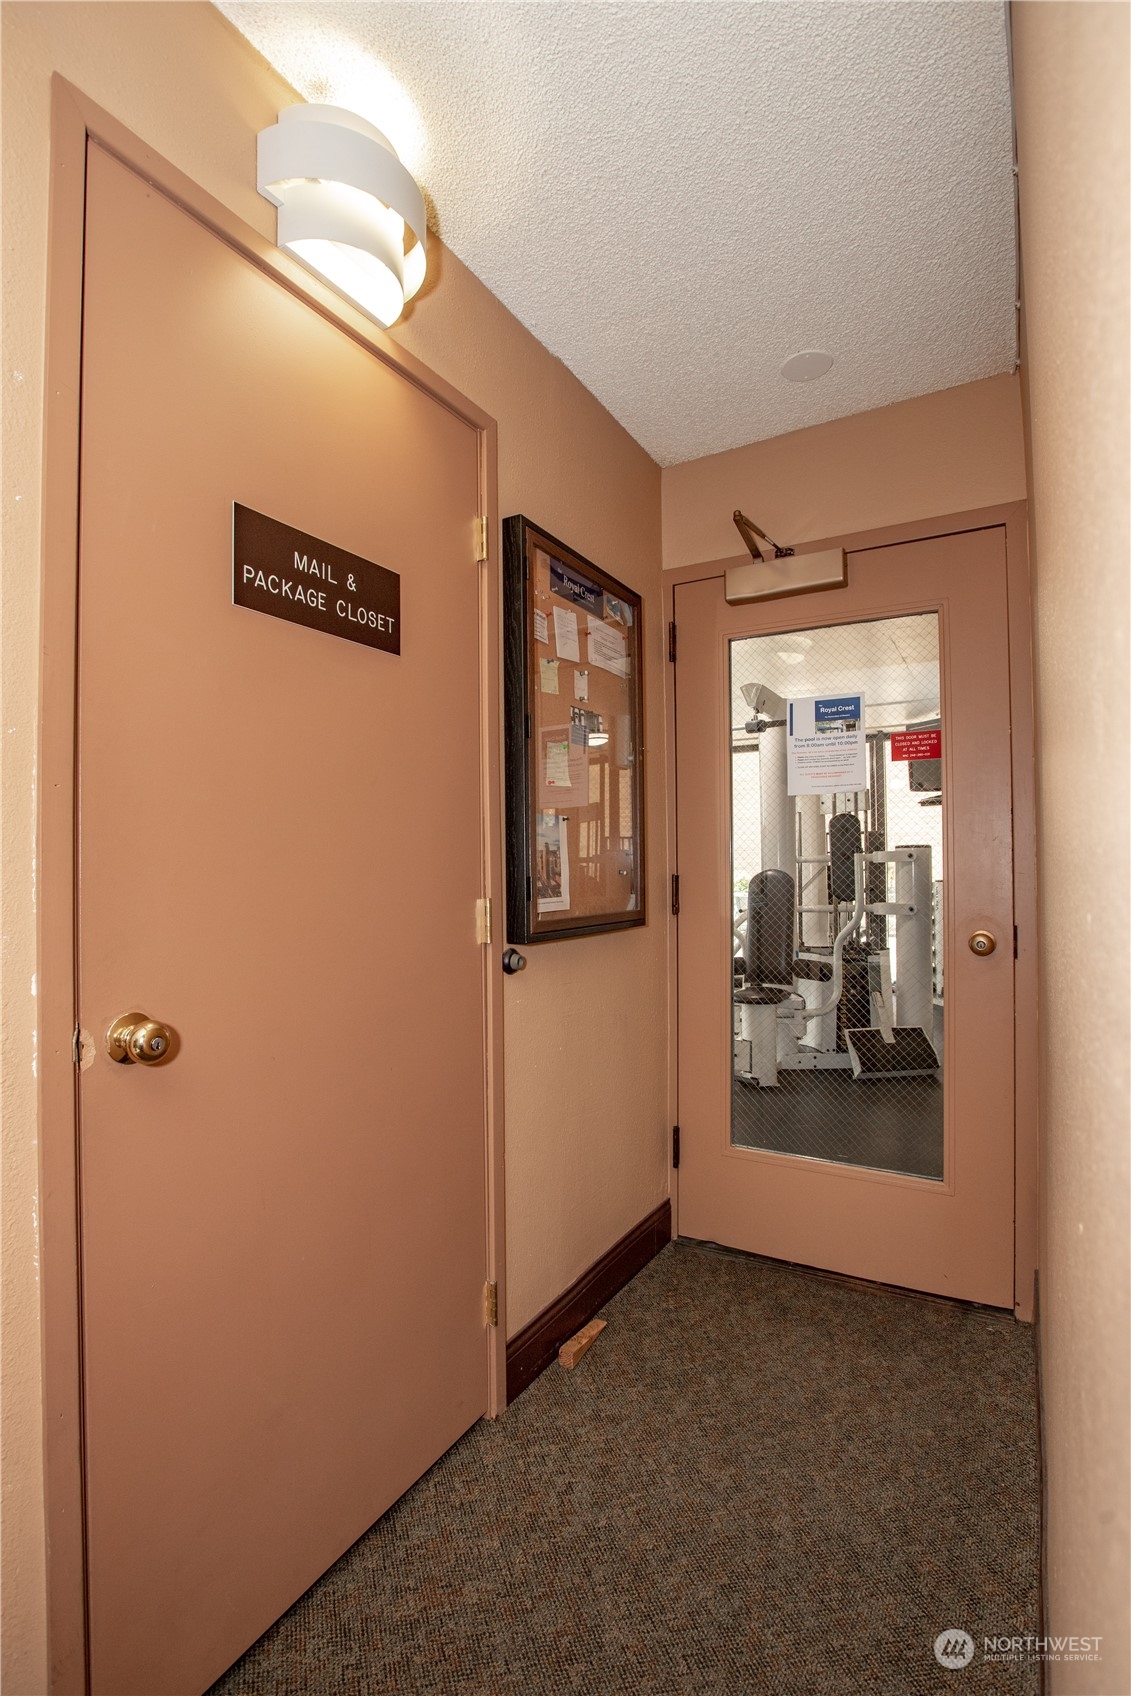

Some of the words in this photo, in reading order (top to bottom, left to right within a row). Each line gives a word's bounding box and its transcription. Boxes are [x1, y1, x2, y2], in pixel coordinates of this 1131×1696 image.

[294, 551, 338, 585] MAIL
[346, 573, 357, 592] &
[563, 574, 580, 594] Royal
[580, 586, 595, 603] Crest
[243, 564, 327, 611] PACKAGE
[336, 599, 395, 634] CLOSET
